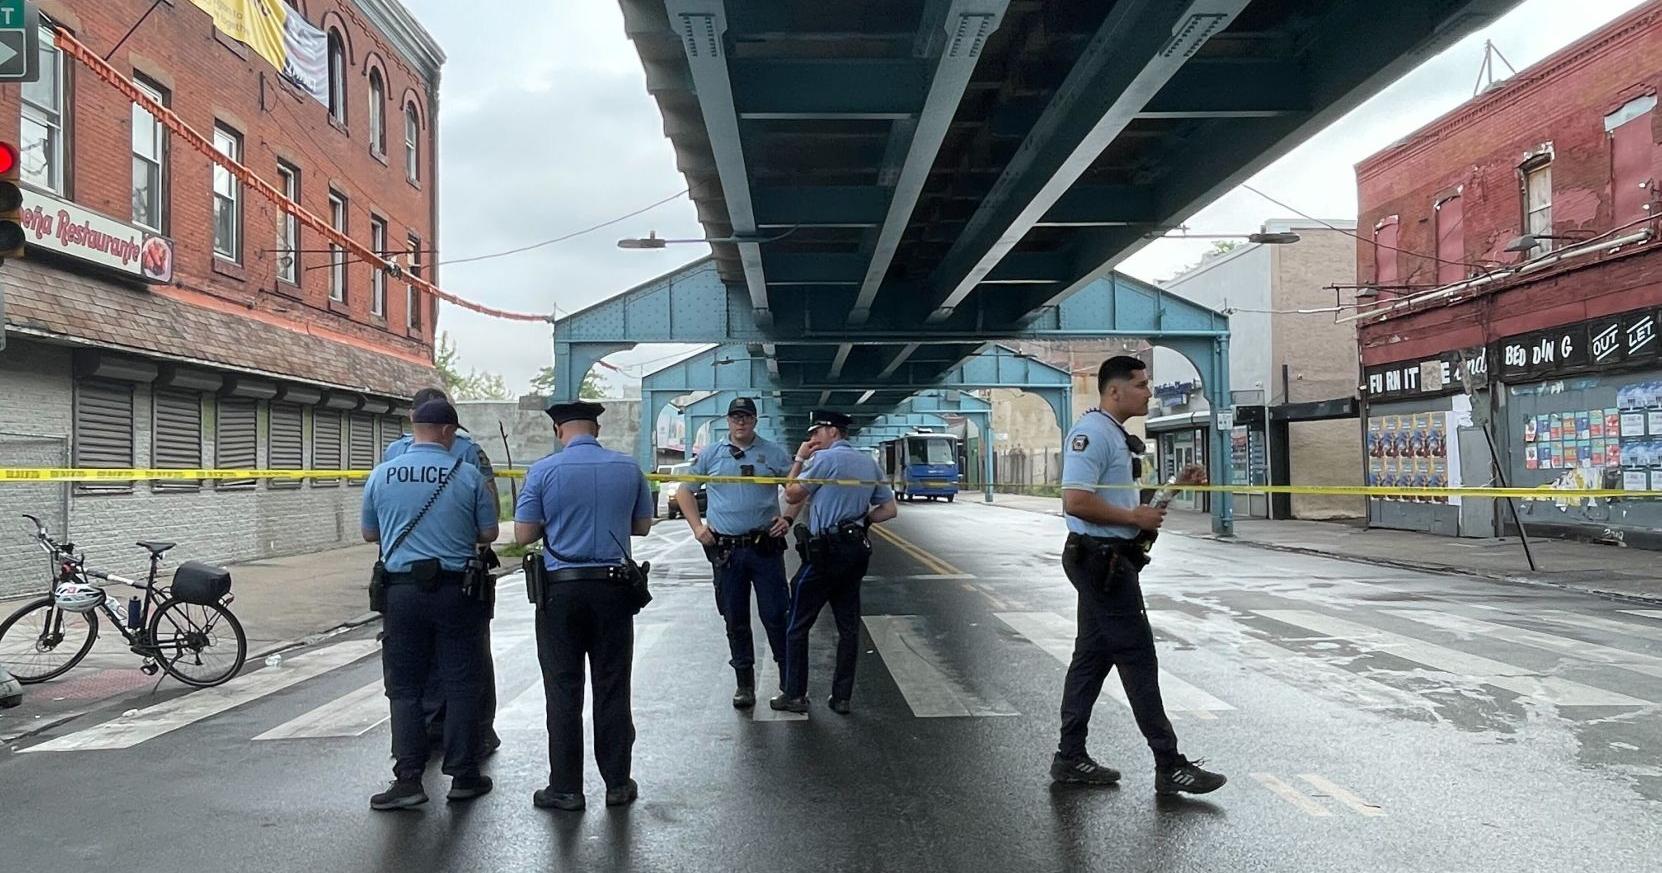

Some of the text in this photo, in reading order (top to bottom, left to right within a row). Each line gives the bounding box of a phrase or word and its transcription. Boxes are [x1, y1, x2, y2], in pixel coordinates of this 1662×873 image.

[20, 205, 140, 265] eña Restaurante
[386, 466, 449, 485] POLICE
